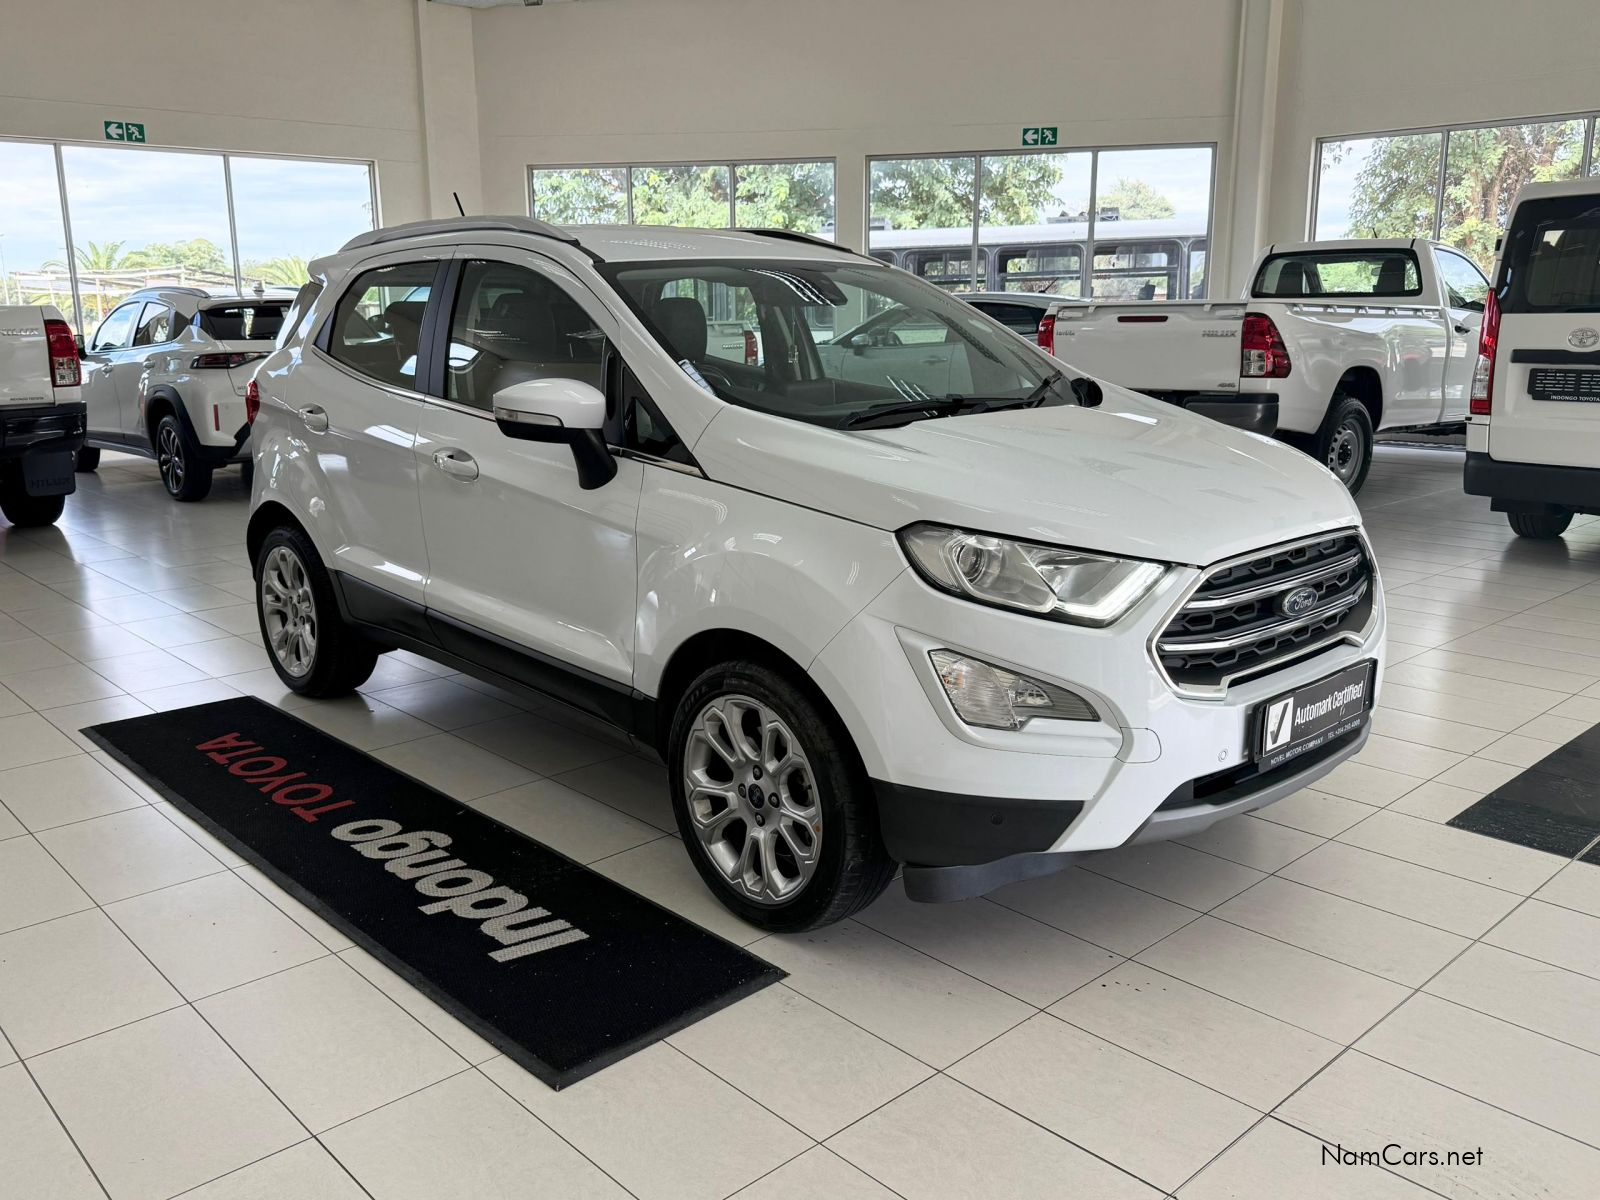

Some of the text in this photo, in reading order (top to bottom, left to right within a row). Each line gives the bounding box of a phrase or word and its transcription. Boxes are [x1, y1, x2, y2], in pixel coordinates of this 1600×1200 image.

[1295, 680, 1363, 726] Automark Certified
[1302, 736, 1323, 751] COMPANY
[195, 731, 357, 824] TOYOTA
